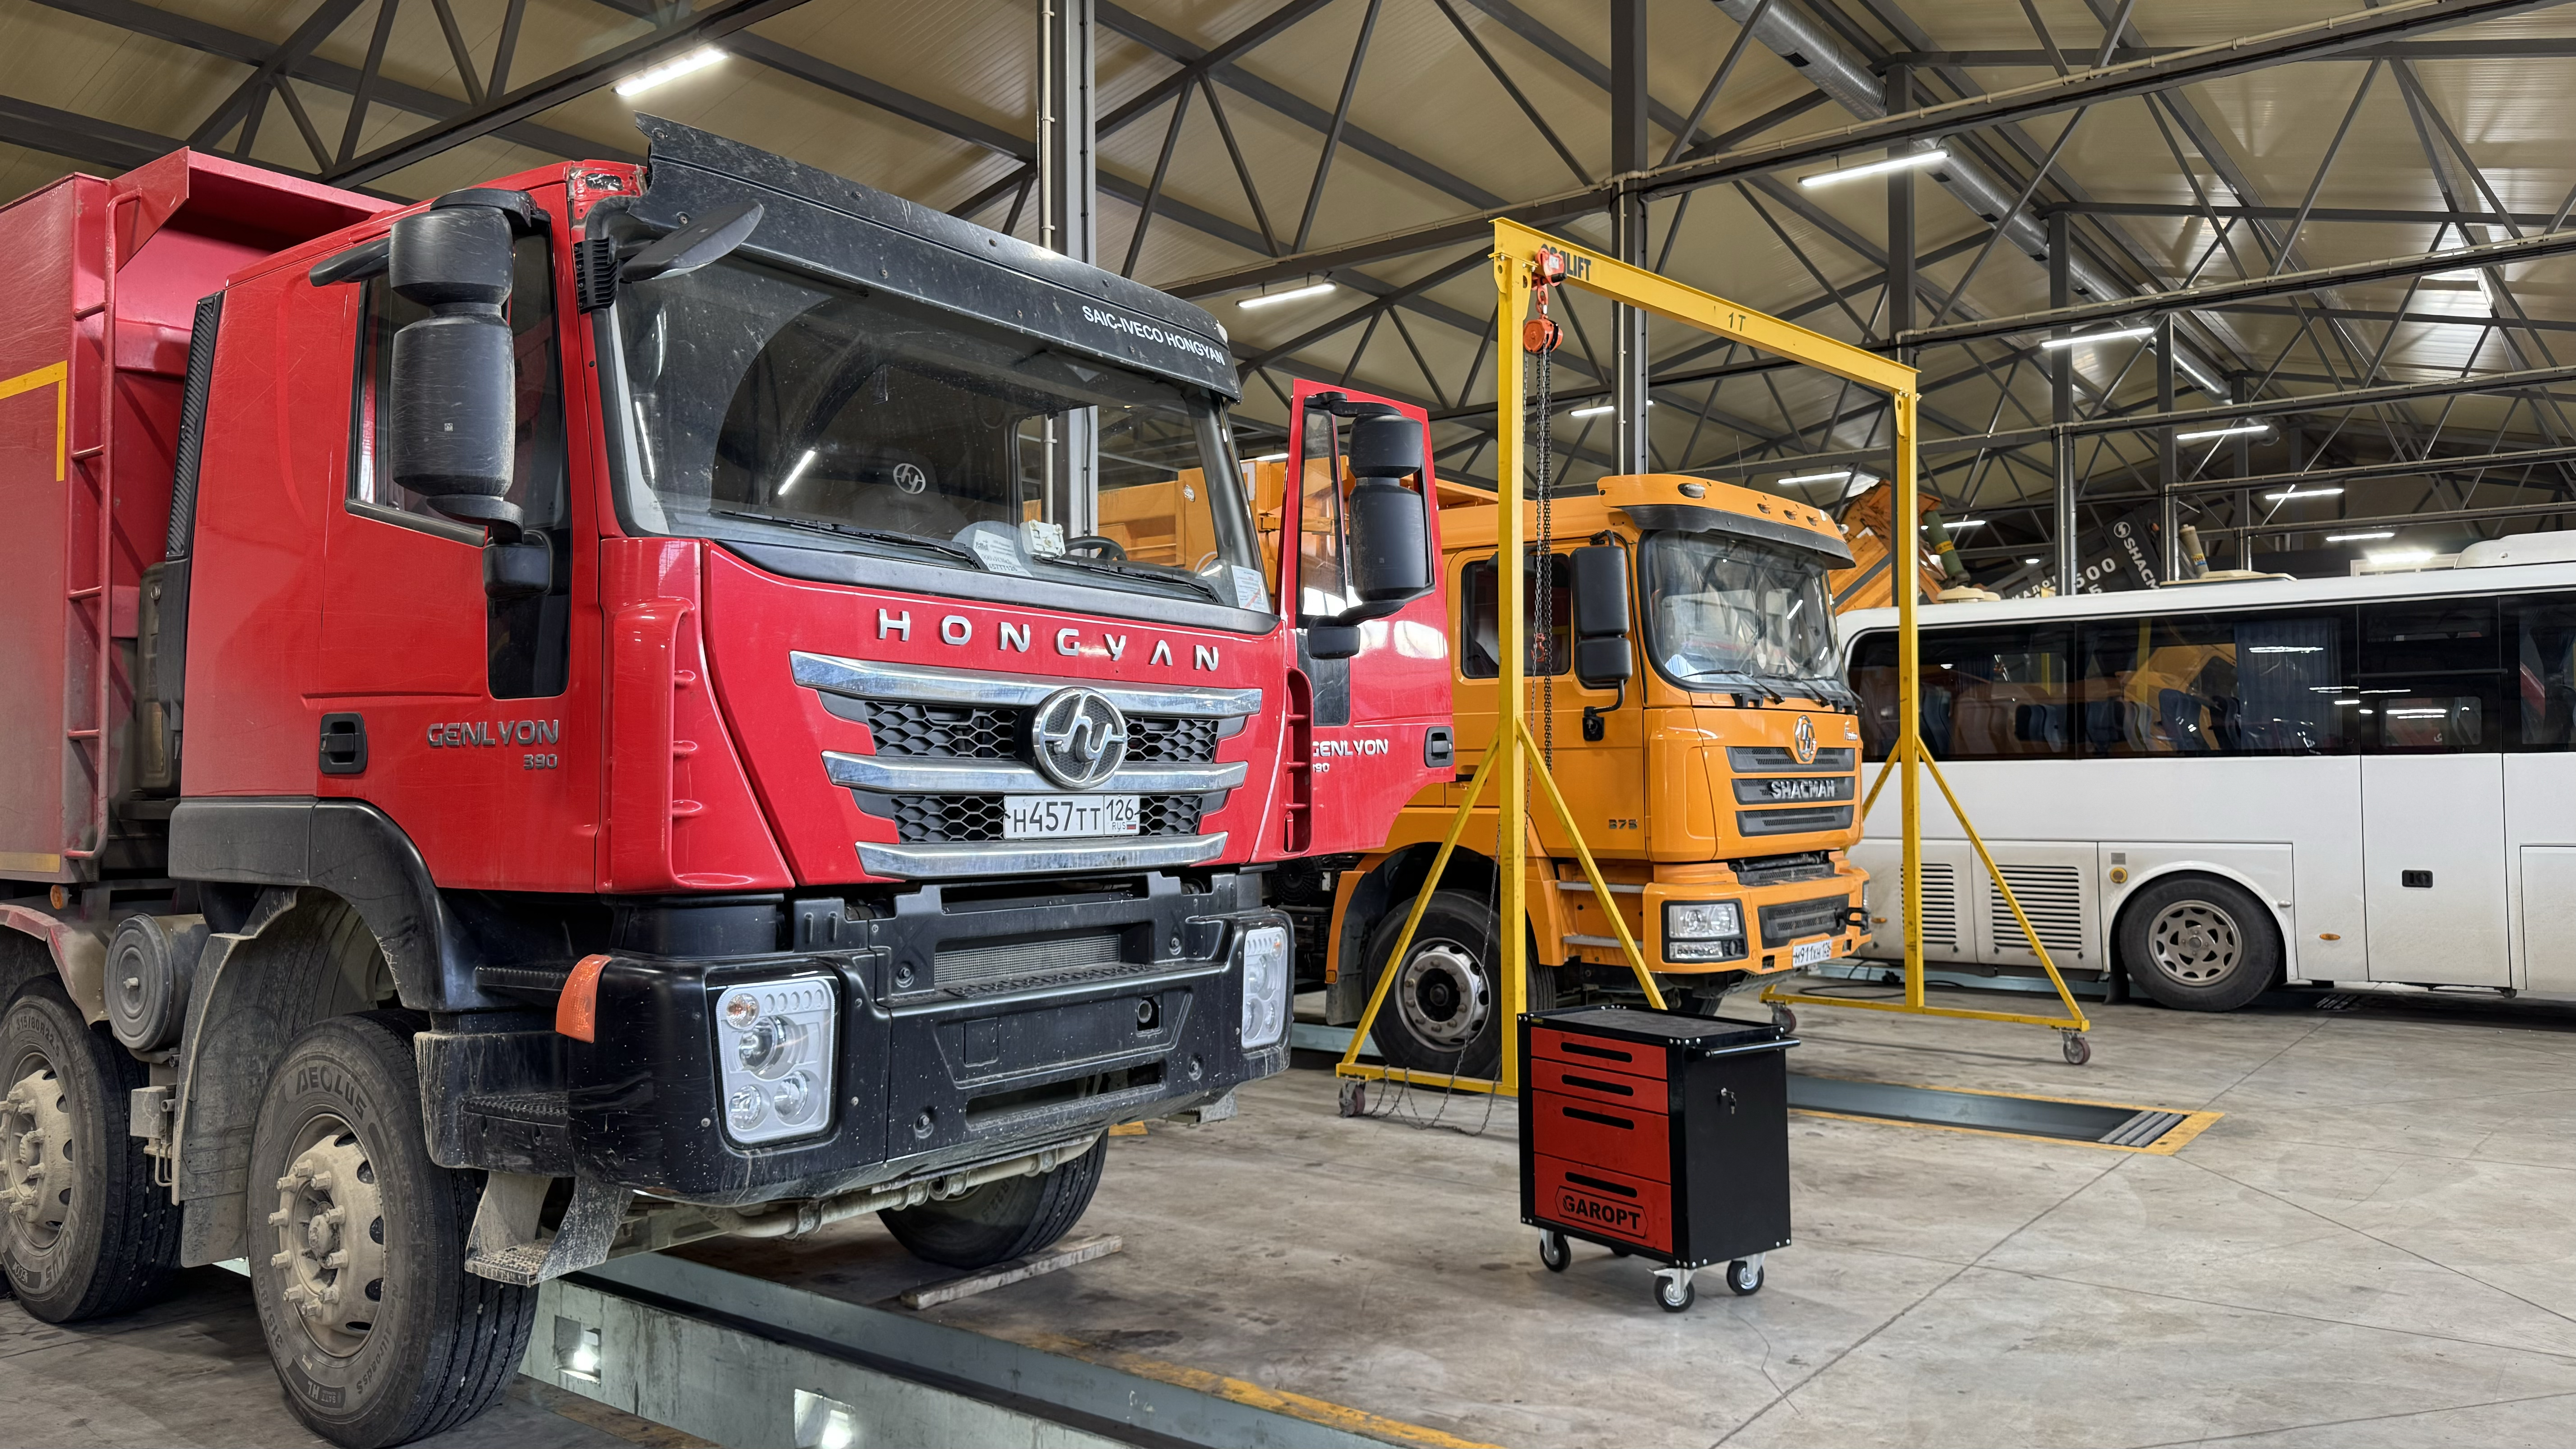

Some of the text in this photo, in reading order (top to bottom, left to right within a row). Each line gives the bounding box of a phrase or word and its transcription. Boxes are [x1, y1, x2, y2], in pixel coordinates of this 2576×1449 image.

[1082, 305, 1226, 366] SAIC-IVECO HONGYAN
[877, 608, 1219, 672] HONGYAN
[426, 719, 559, 747] GENLYON
[523, 754, 559, 769] 390
[1312, 763, 1330, 773] 90
[1770, 779, 1835, 800] SHACMAN
[1106, 799, 1134, 821] 126
[1112, 821, 1126, 831] RUS
[295, 1065, 368, 1121] AEOLUS
[1562, 1195, 1641, 1230] GAROPT
